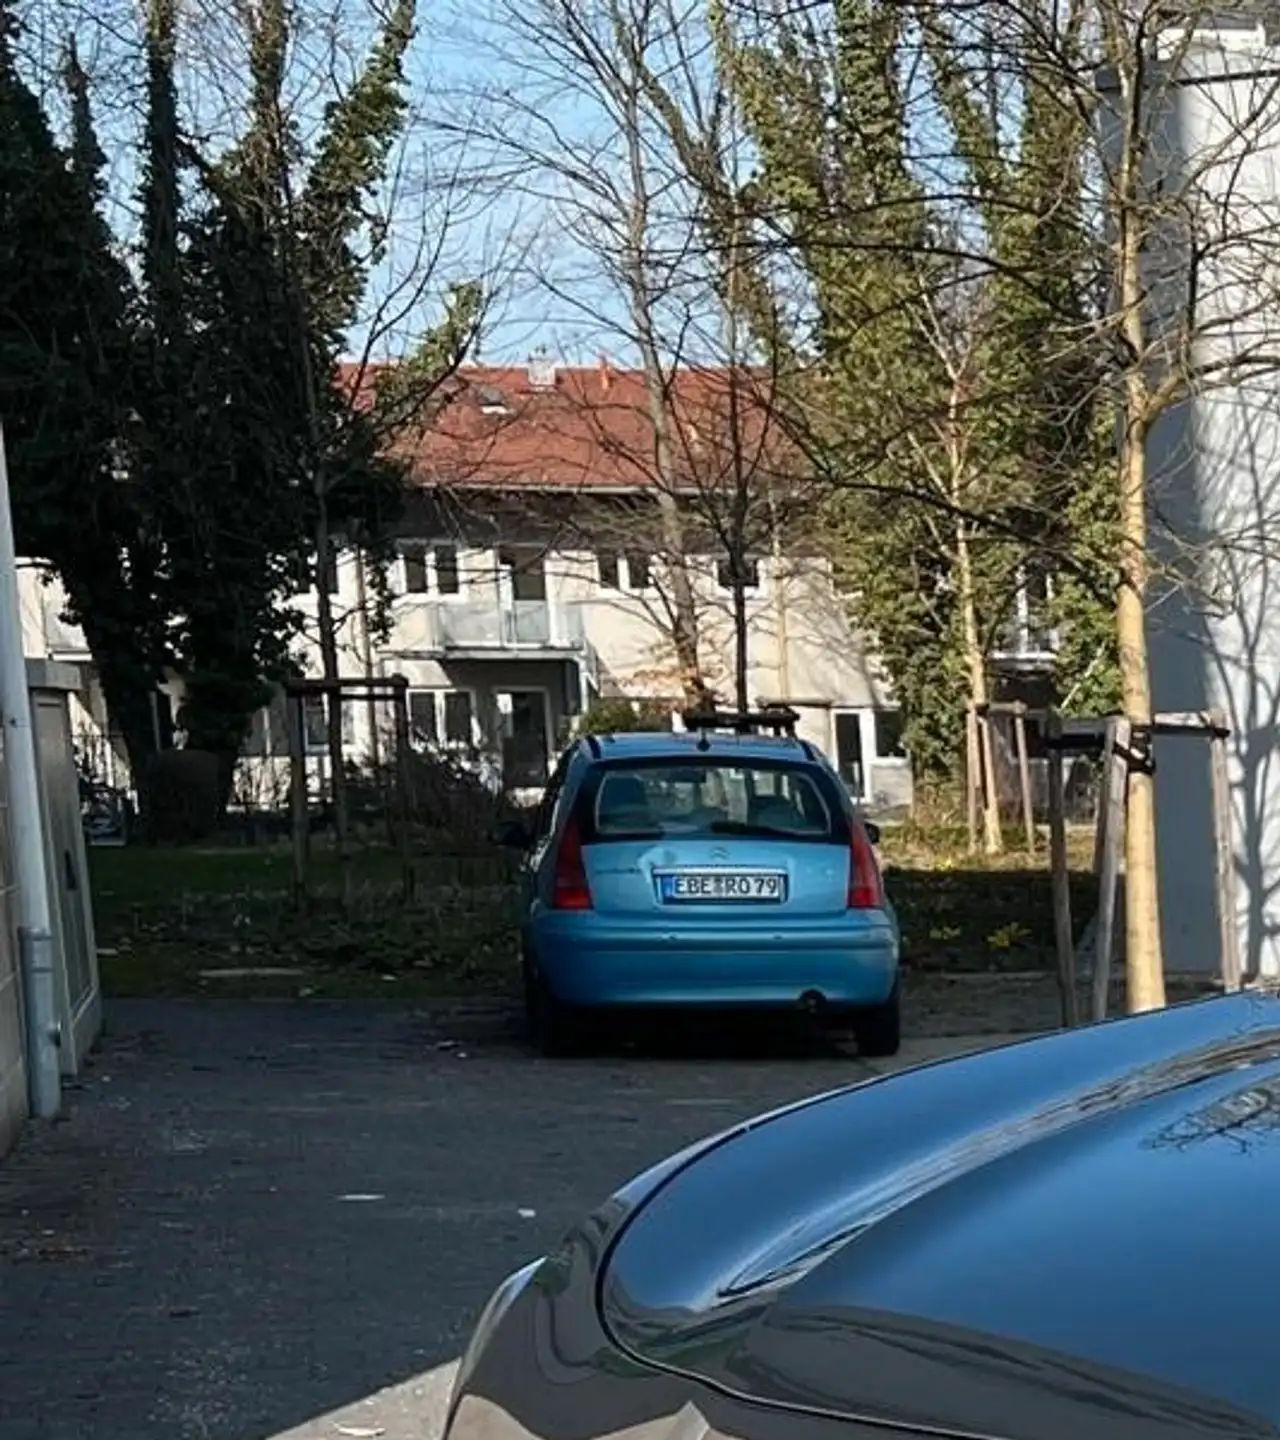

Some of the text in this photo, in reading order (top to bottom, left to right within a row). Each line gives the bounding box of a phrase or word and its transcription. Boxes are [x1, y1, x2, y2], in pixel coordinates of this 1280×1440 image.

[674, 874, 779, 895] EBE RO 79
